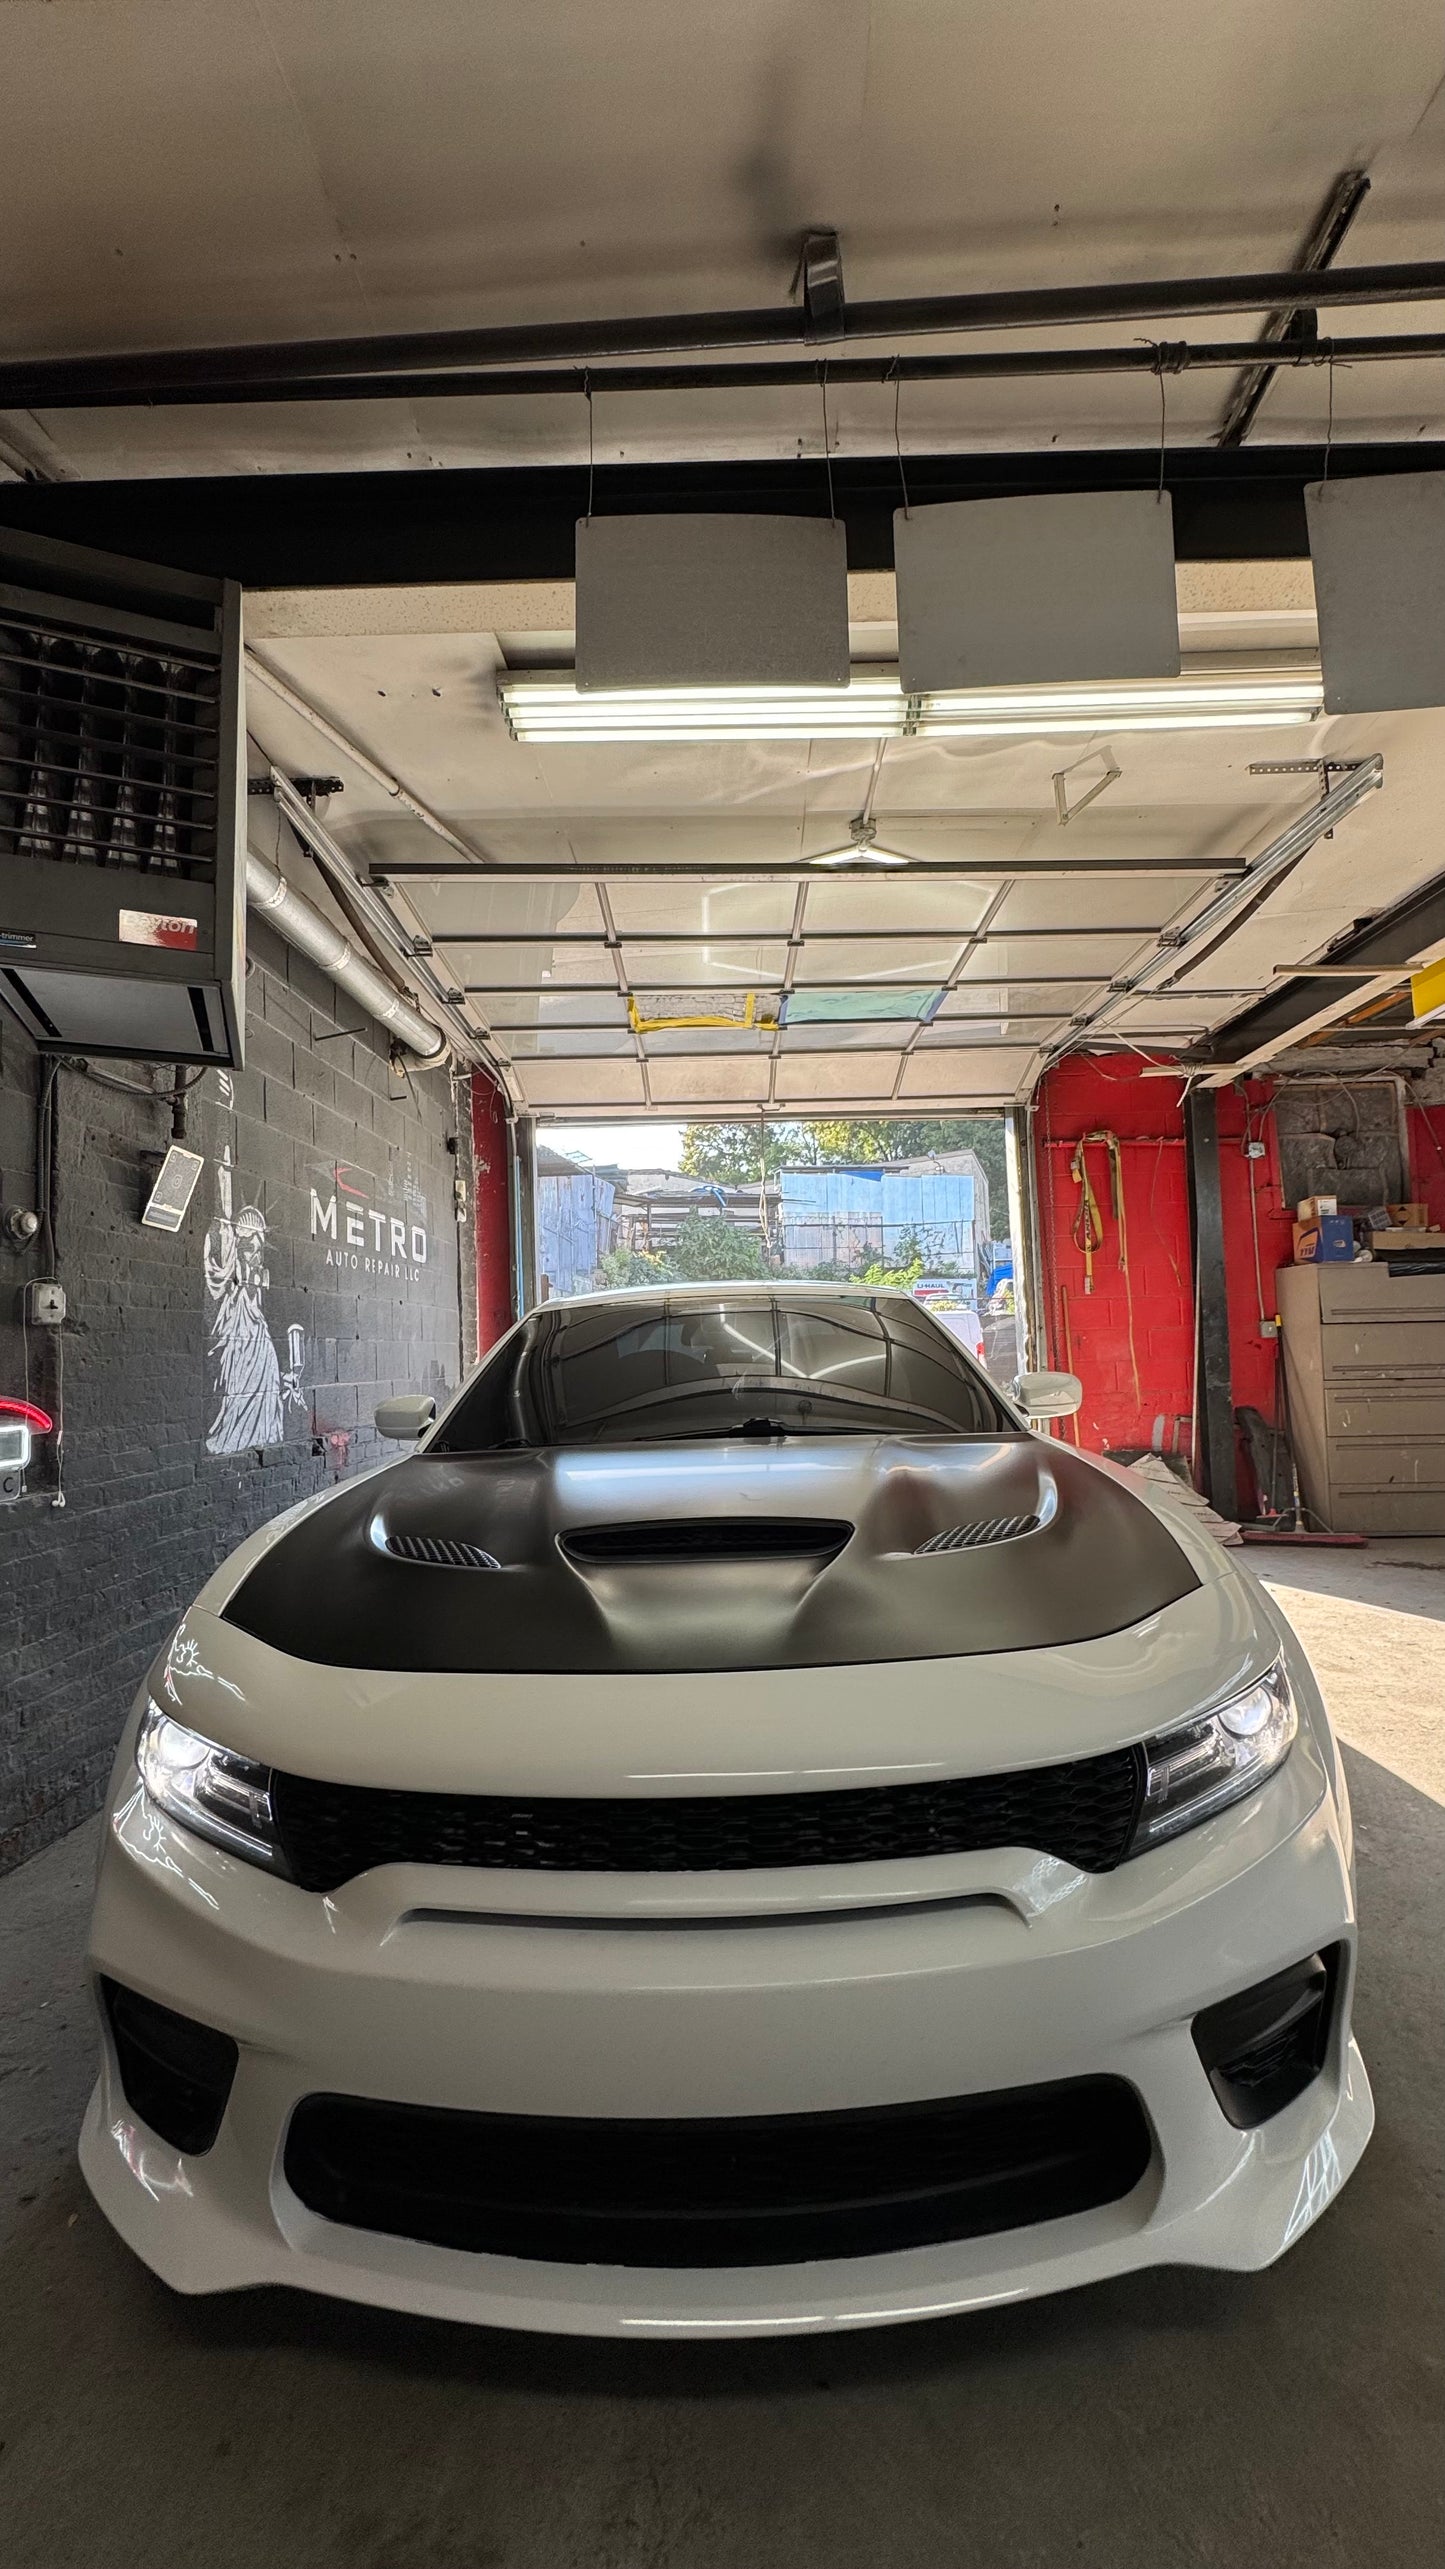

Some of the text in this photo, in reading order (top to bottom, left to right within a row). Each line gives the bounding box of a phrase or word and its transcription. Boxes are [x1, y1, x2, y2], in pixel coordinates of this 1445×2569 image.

[310, 1187, 427, 1264] METRO
[326, 1249, 420, 1282] AUTO REPAIR LLC
